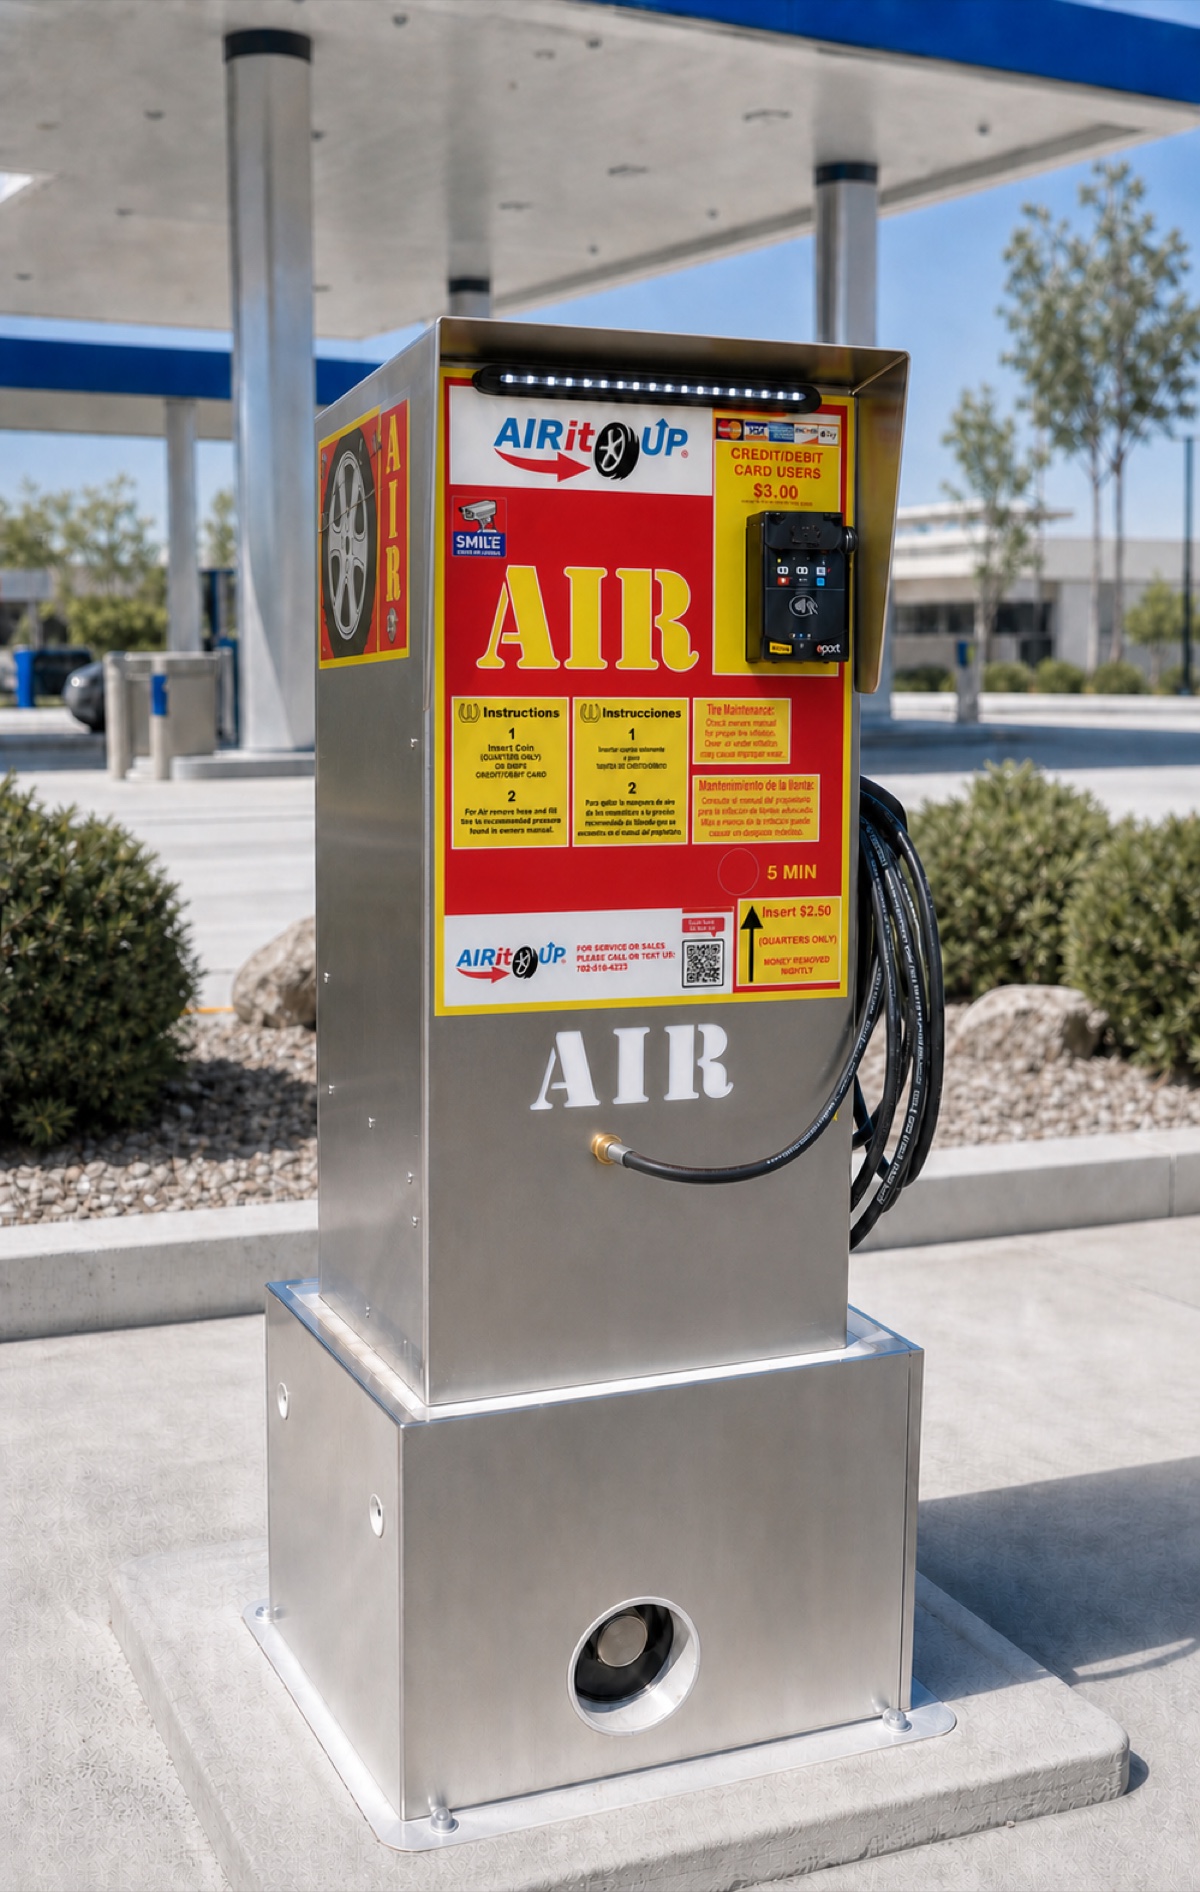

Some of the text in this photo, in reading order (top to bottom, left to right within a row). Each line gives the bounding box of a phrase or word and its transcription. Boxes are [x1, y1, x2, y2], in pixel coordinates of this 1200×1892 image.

[731, 447, 823, 464] CREDIT/DEBIT
[734, 465, 821, 479] CARD USERS
[753, 483, 799, 500] $3.00
[385, 414, 401, 602] AIR
[456, 535, 501, 549] SMILE
[476, 565, 699, 673] AIR
[483, 707, 560, 718] Instructions
[603, 708, 681, 719] Instrucciones
[707, 703, 775, 715] Tire Maintenance:
[508, 727, 515, 740] 1
[628, 728, 635, 740] 1
[488, 744, 534, 752] Insert Coin
[628, 782, 637, 794] 2
[507, 790, 516, 802] 2
[767, 864, 817, 880] 5 MIN
[762, 905, 831, 918] Insert $2.50
[594, 943, 627, 951] SERVICE
[641, 942, 666, 950] SALES
[759, 935, 837, 947] (QUARTERS ONLY)
[576, 954, 605, 962] PLEASE
[608, 953, 627, 961] CALL
[642, 952, 660, 960] TEXT
[764, 956, 830, 966] MONEY REMOVED
[781, 967, 814, 975] NIGHTLY
[530, 1023, 734, 1110] AIR
